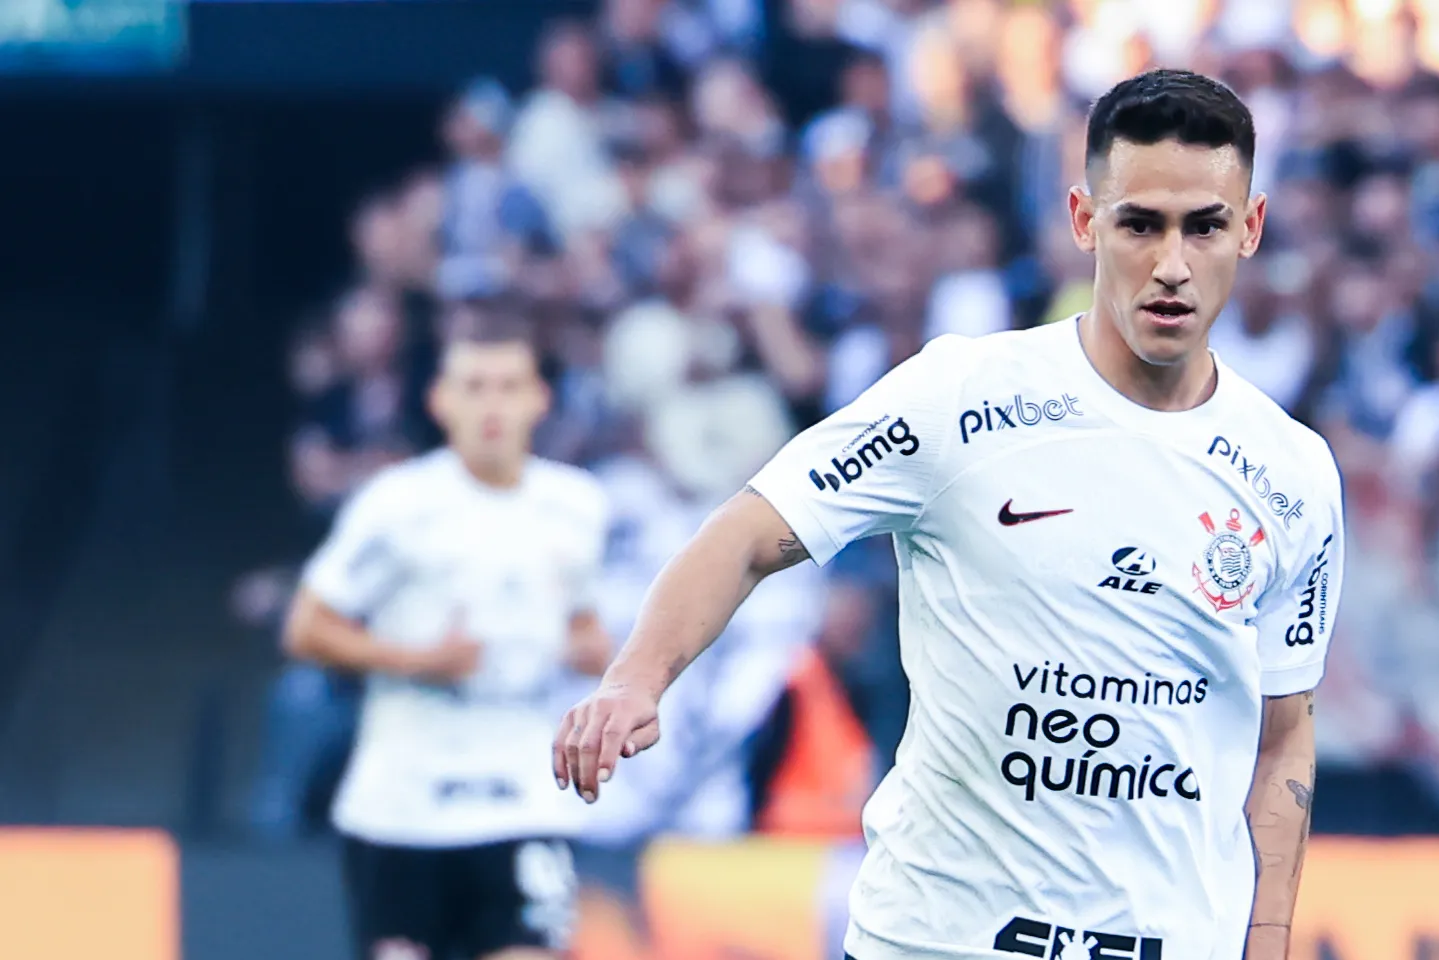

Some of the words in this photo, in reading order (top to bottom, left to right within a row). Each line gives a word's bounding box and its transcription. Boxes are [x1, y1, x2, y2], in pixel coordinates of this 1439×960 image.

[959, 393, 1084, 444] pixbet
[831, 416, 920, 485] bmg
[1207, 435, 1305, 531] pixbet
[1096, 575, 1164, 595] ALE
[1012, 660, 1209, 705] vitaminas
[1004, 702, 1121, 749] neo
[1000, 749, 1201, 802] química
